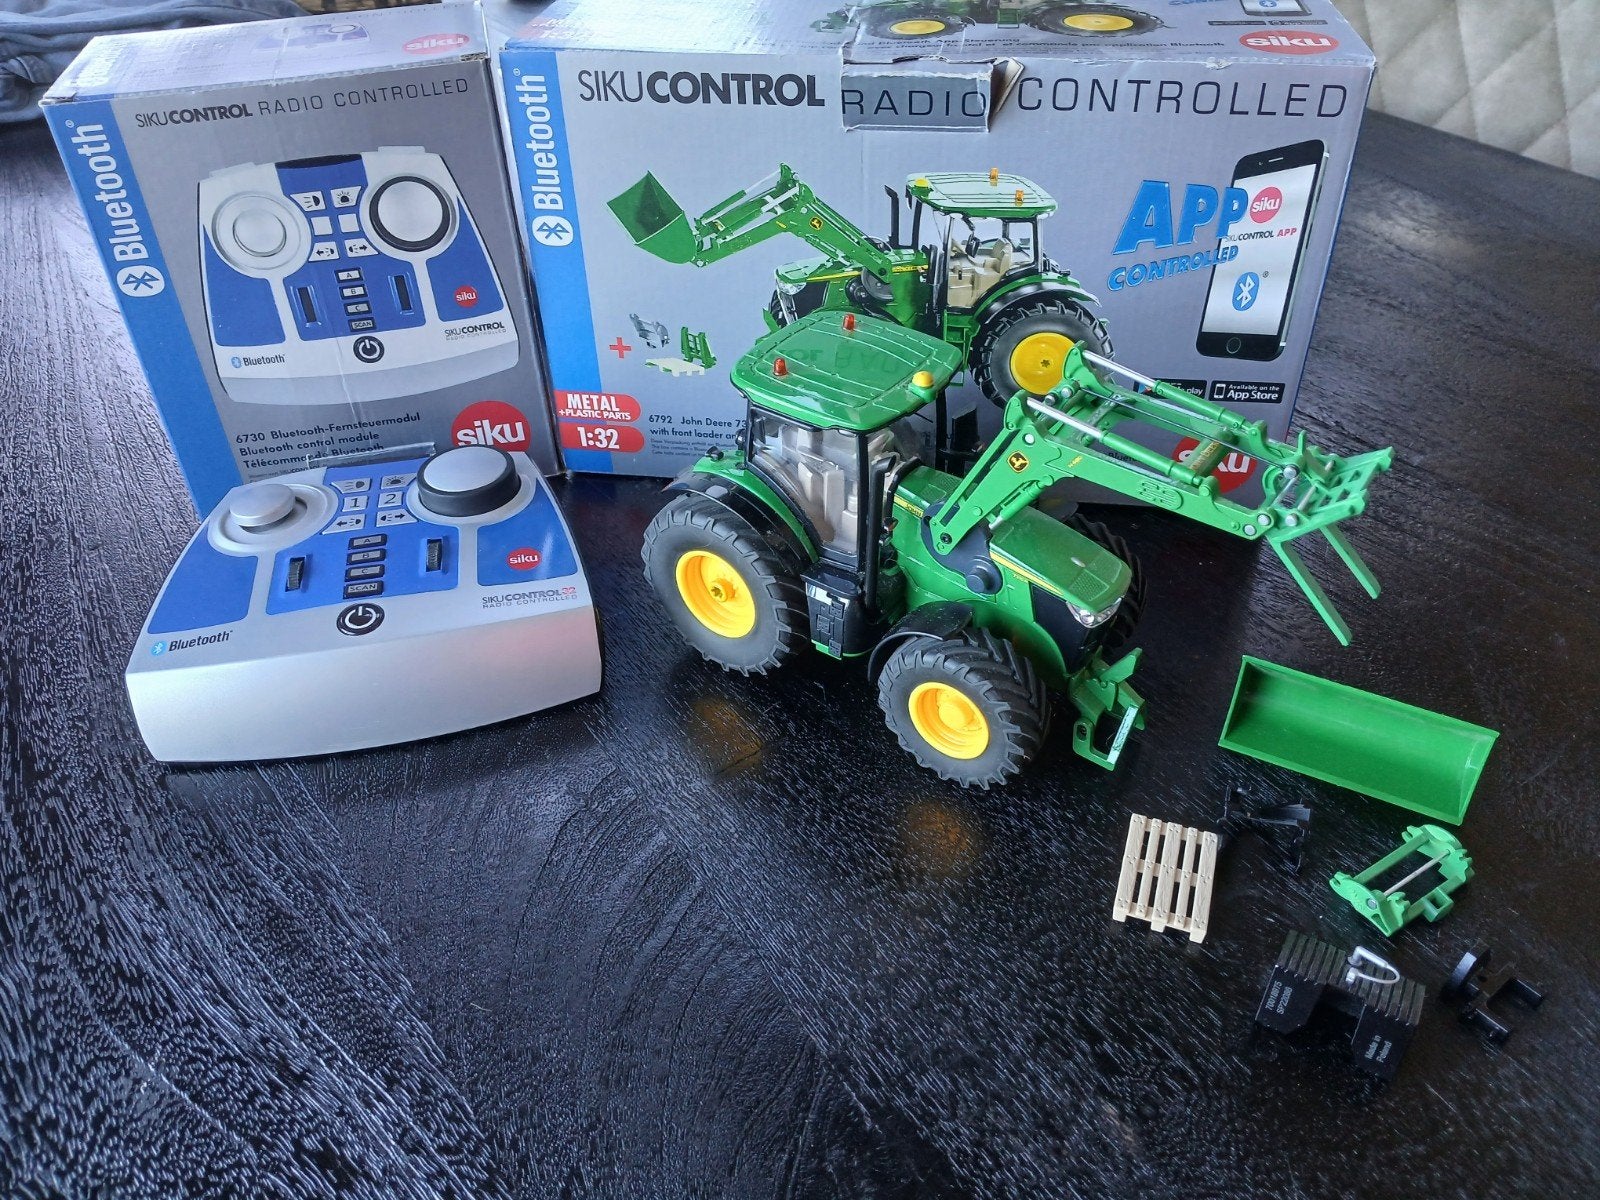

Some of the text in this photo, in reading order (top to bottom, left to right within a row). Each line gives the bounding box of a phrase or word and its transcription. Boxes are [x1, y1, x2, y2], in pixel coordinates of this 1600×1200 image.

[405, 35, 466, 51] siku
[1245, 35, 1332, 47] siku
[577, 70, 1348, 119] SIKUCONTROL RADIO CONTROLLED
[134, 78, 469, 128] SIKUCONTROL RADIO CONTROLLED
[1251, 195, 1281, 213] siku
[1111, 180, 1249, 255] APP
[1277, 227, 1298, 238] APP
[1107, 245, 1239, 292] CONTROLLED
[456, 291, 477, 303] siku
[353, 320, 373, 330] SCAN
[444, 321, 505, 337] SIKUCONTROL
[566, 393, 621, 412] METAL
[1226, 389, 1279, 401] App Store
[603, 410, 632, 421] PARTS
[648, 414, 673, 424] 6792
[680, 416, 703, 426] John
[705, 417, 733, 428] Deere
[235, 431, 267, 445] 6730
[456, 418, 526, 447] siku
[577, 426, 621, 450] 1:32
[649, 427, 669, 436] with
[671, 427, 692, 437] front
[694, 428, 723, 439] loader
[239, 431, 380, 457] Bluetooth control module
[333, 442, 384, 457] Bluetooth
[349, 493, 397, 508] 1 2
[509, 554, 539, 564] siku
[349, 583, 377, 592] SCAN
[482, 601, 513, 609] RADIO
